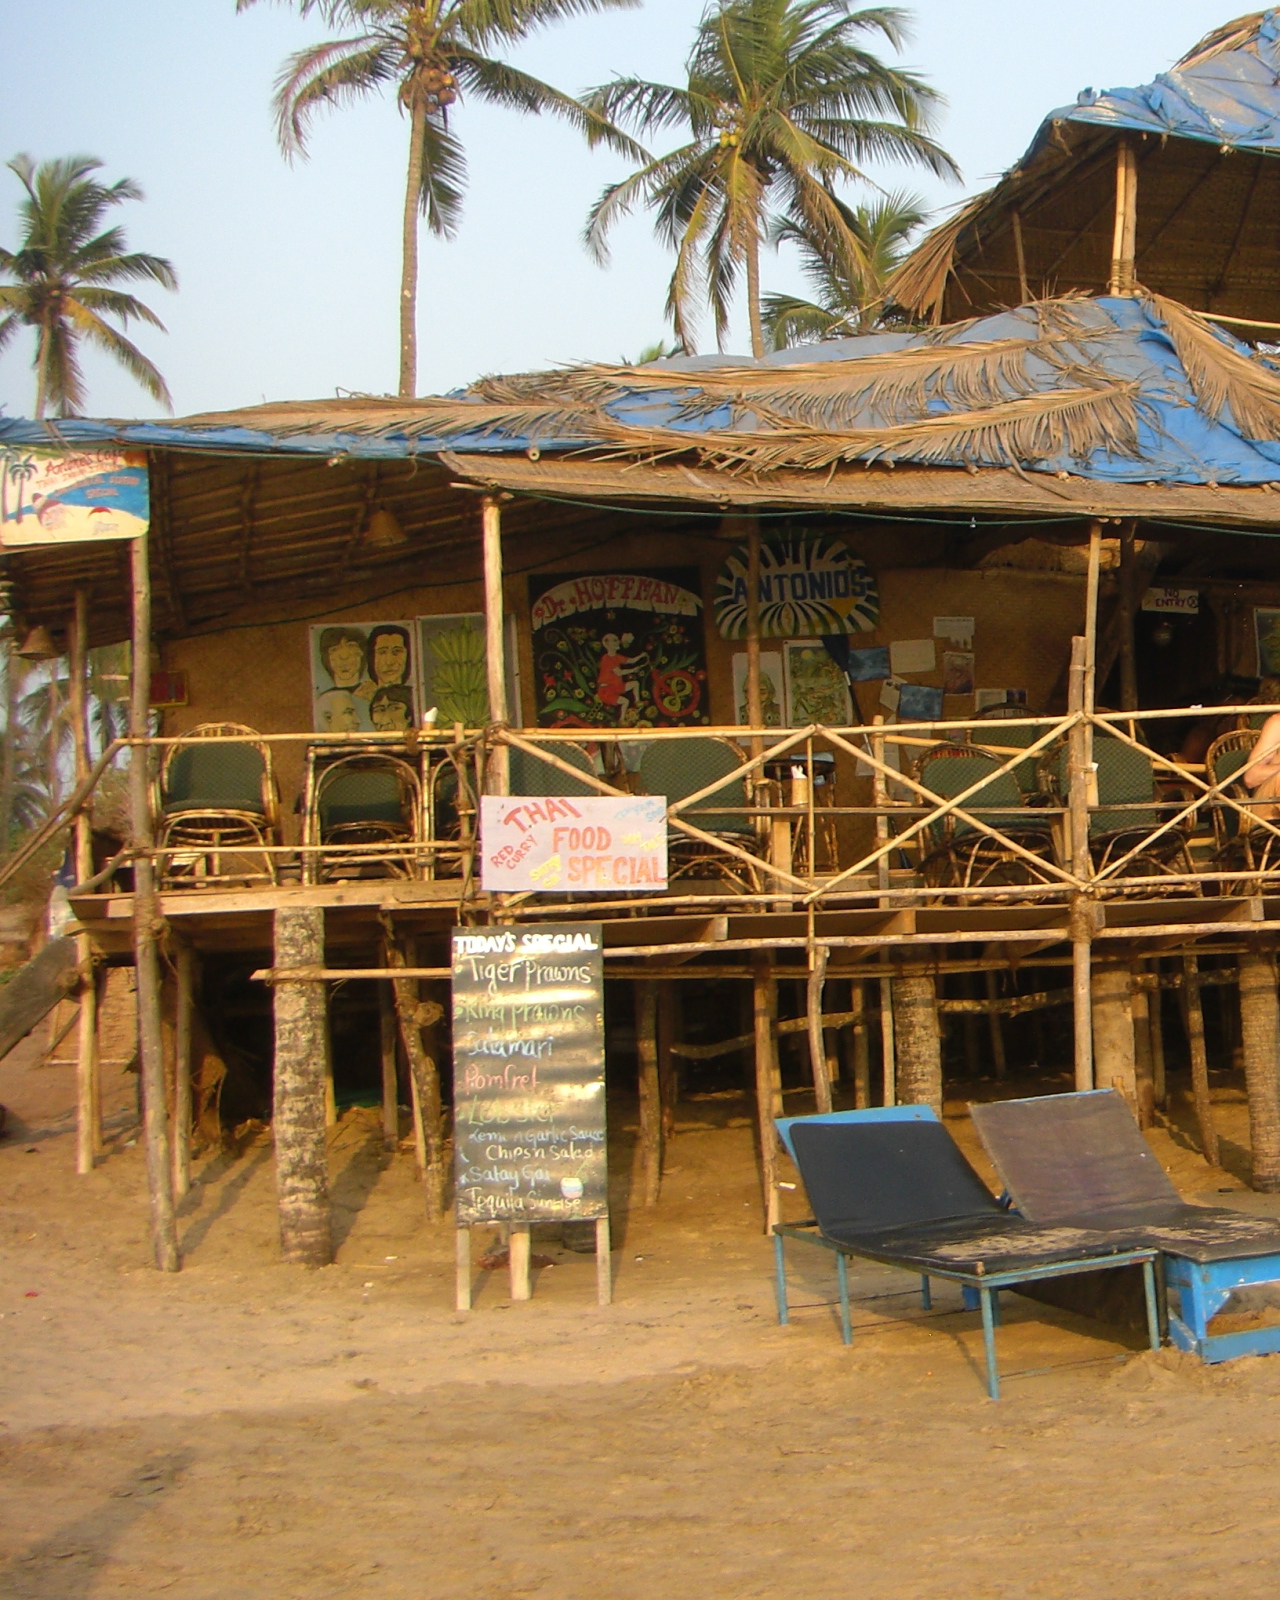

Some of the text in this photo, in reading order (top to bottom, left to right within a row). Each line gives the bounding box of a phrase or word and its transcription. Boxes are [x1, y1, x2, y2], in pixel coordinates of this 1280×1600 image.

[574, 576, 681, 606] HOFFMAN
[1155, 598, 1186, 607] ENTRY
[1164, 588, 1180, 598] NO
[503, 798, 582, 833] THAI
[506, 834, 538, 870] CURRY
[552, 826, 612, 853] FOOD
[490, 844, 514, 867] RED
[567, 855, 667, 886] SPECIAL
[453, 931, 599, 954] TODAY'S SPECIAL
[460, 955, 521, 996] Tiger
[464, 1063, 541, 1095] Pomfret
[486, 1144, 531, 1161] Chips
[469, 1165, 520, 1190] Satay
[465, 1186, 525, 1218] Tequila
